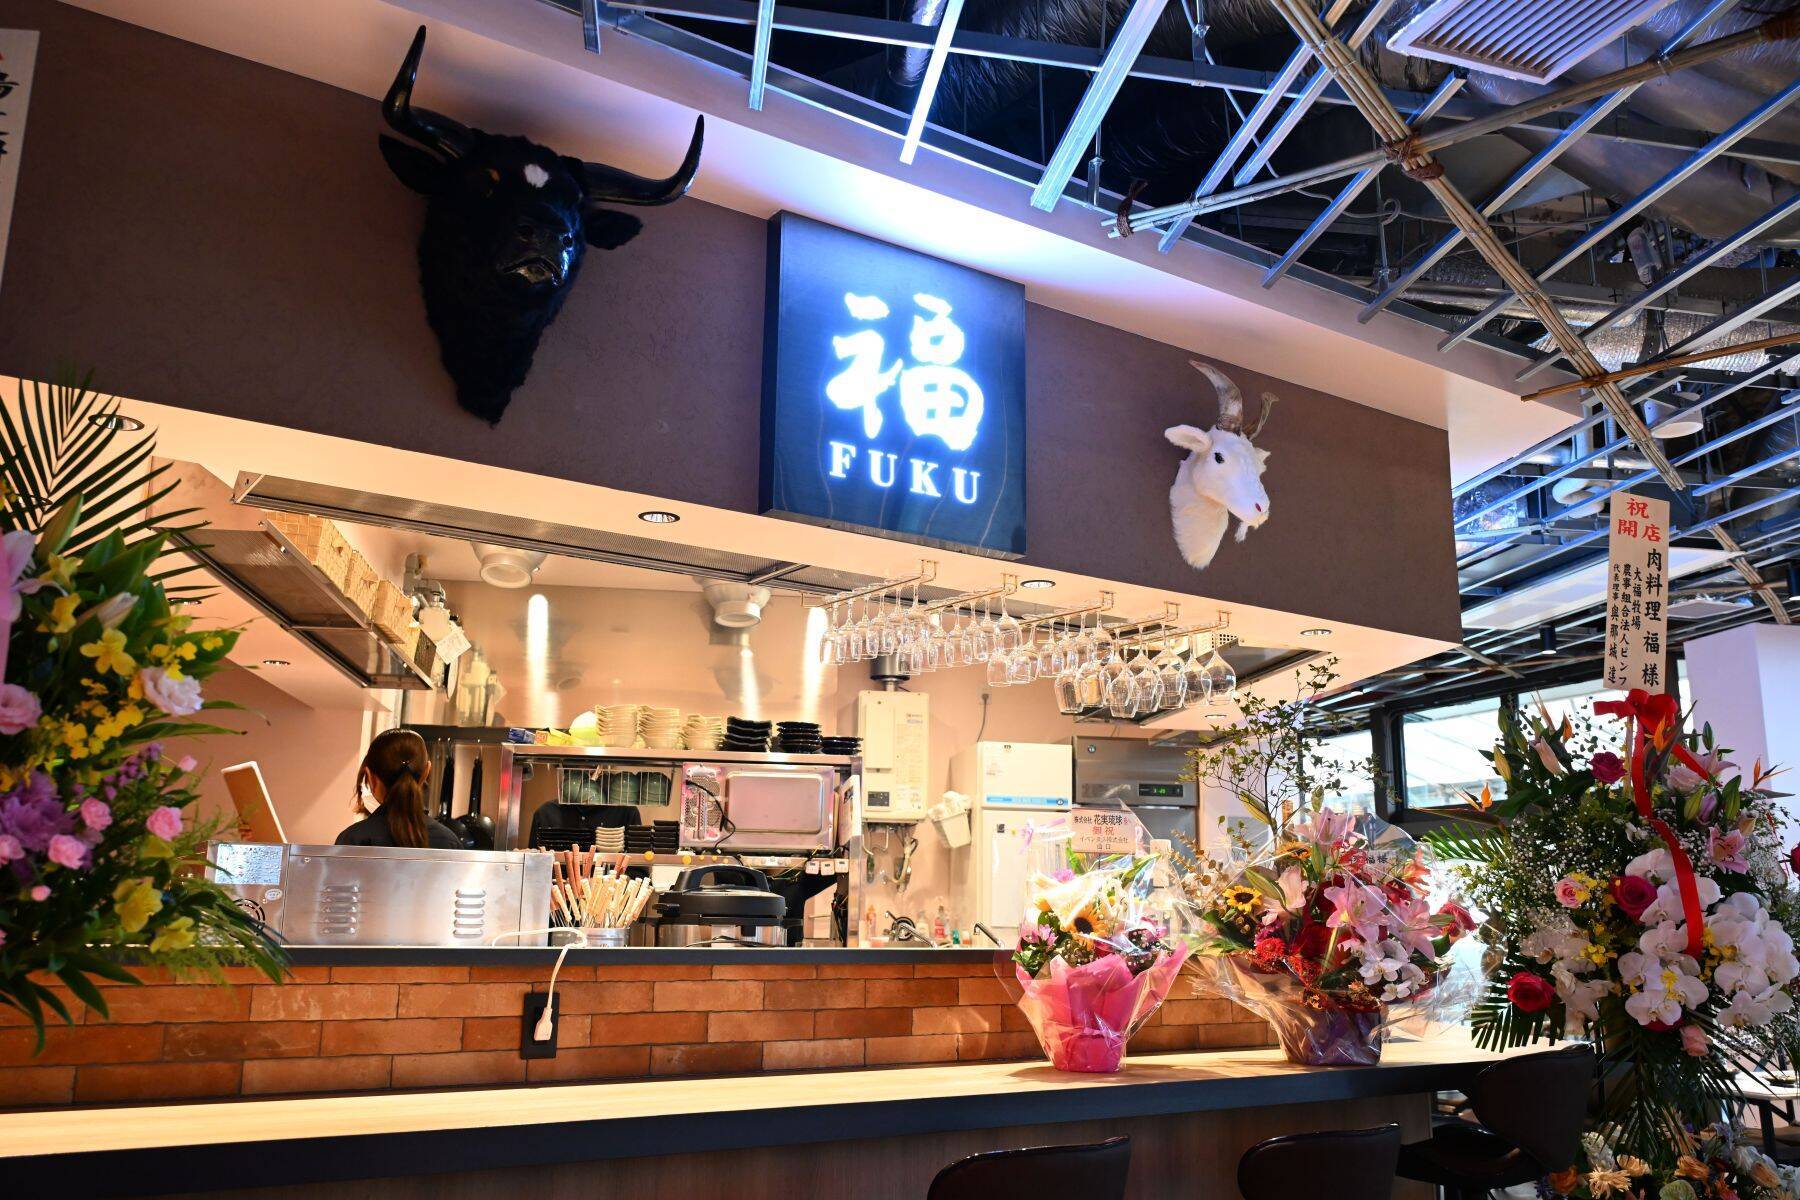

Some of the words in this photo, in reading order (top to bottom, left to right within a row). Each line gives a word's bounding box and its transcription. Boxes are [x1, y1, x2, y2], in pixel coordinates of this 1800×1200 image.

[826, 292, 985, 451] 福
[829, 441, 981, 505] FUKU
[1617, 518, 1662, 542] 開店
[1626, 498, 1650, 519] 祝
[1631, 566, 1642, 630] 大福牧場
